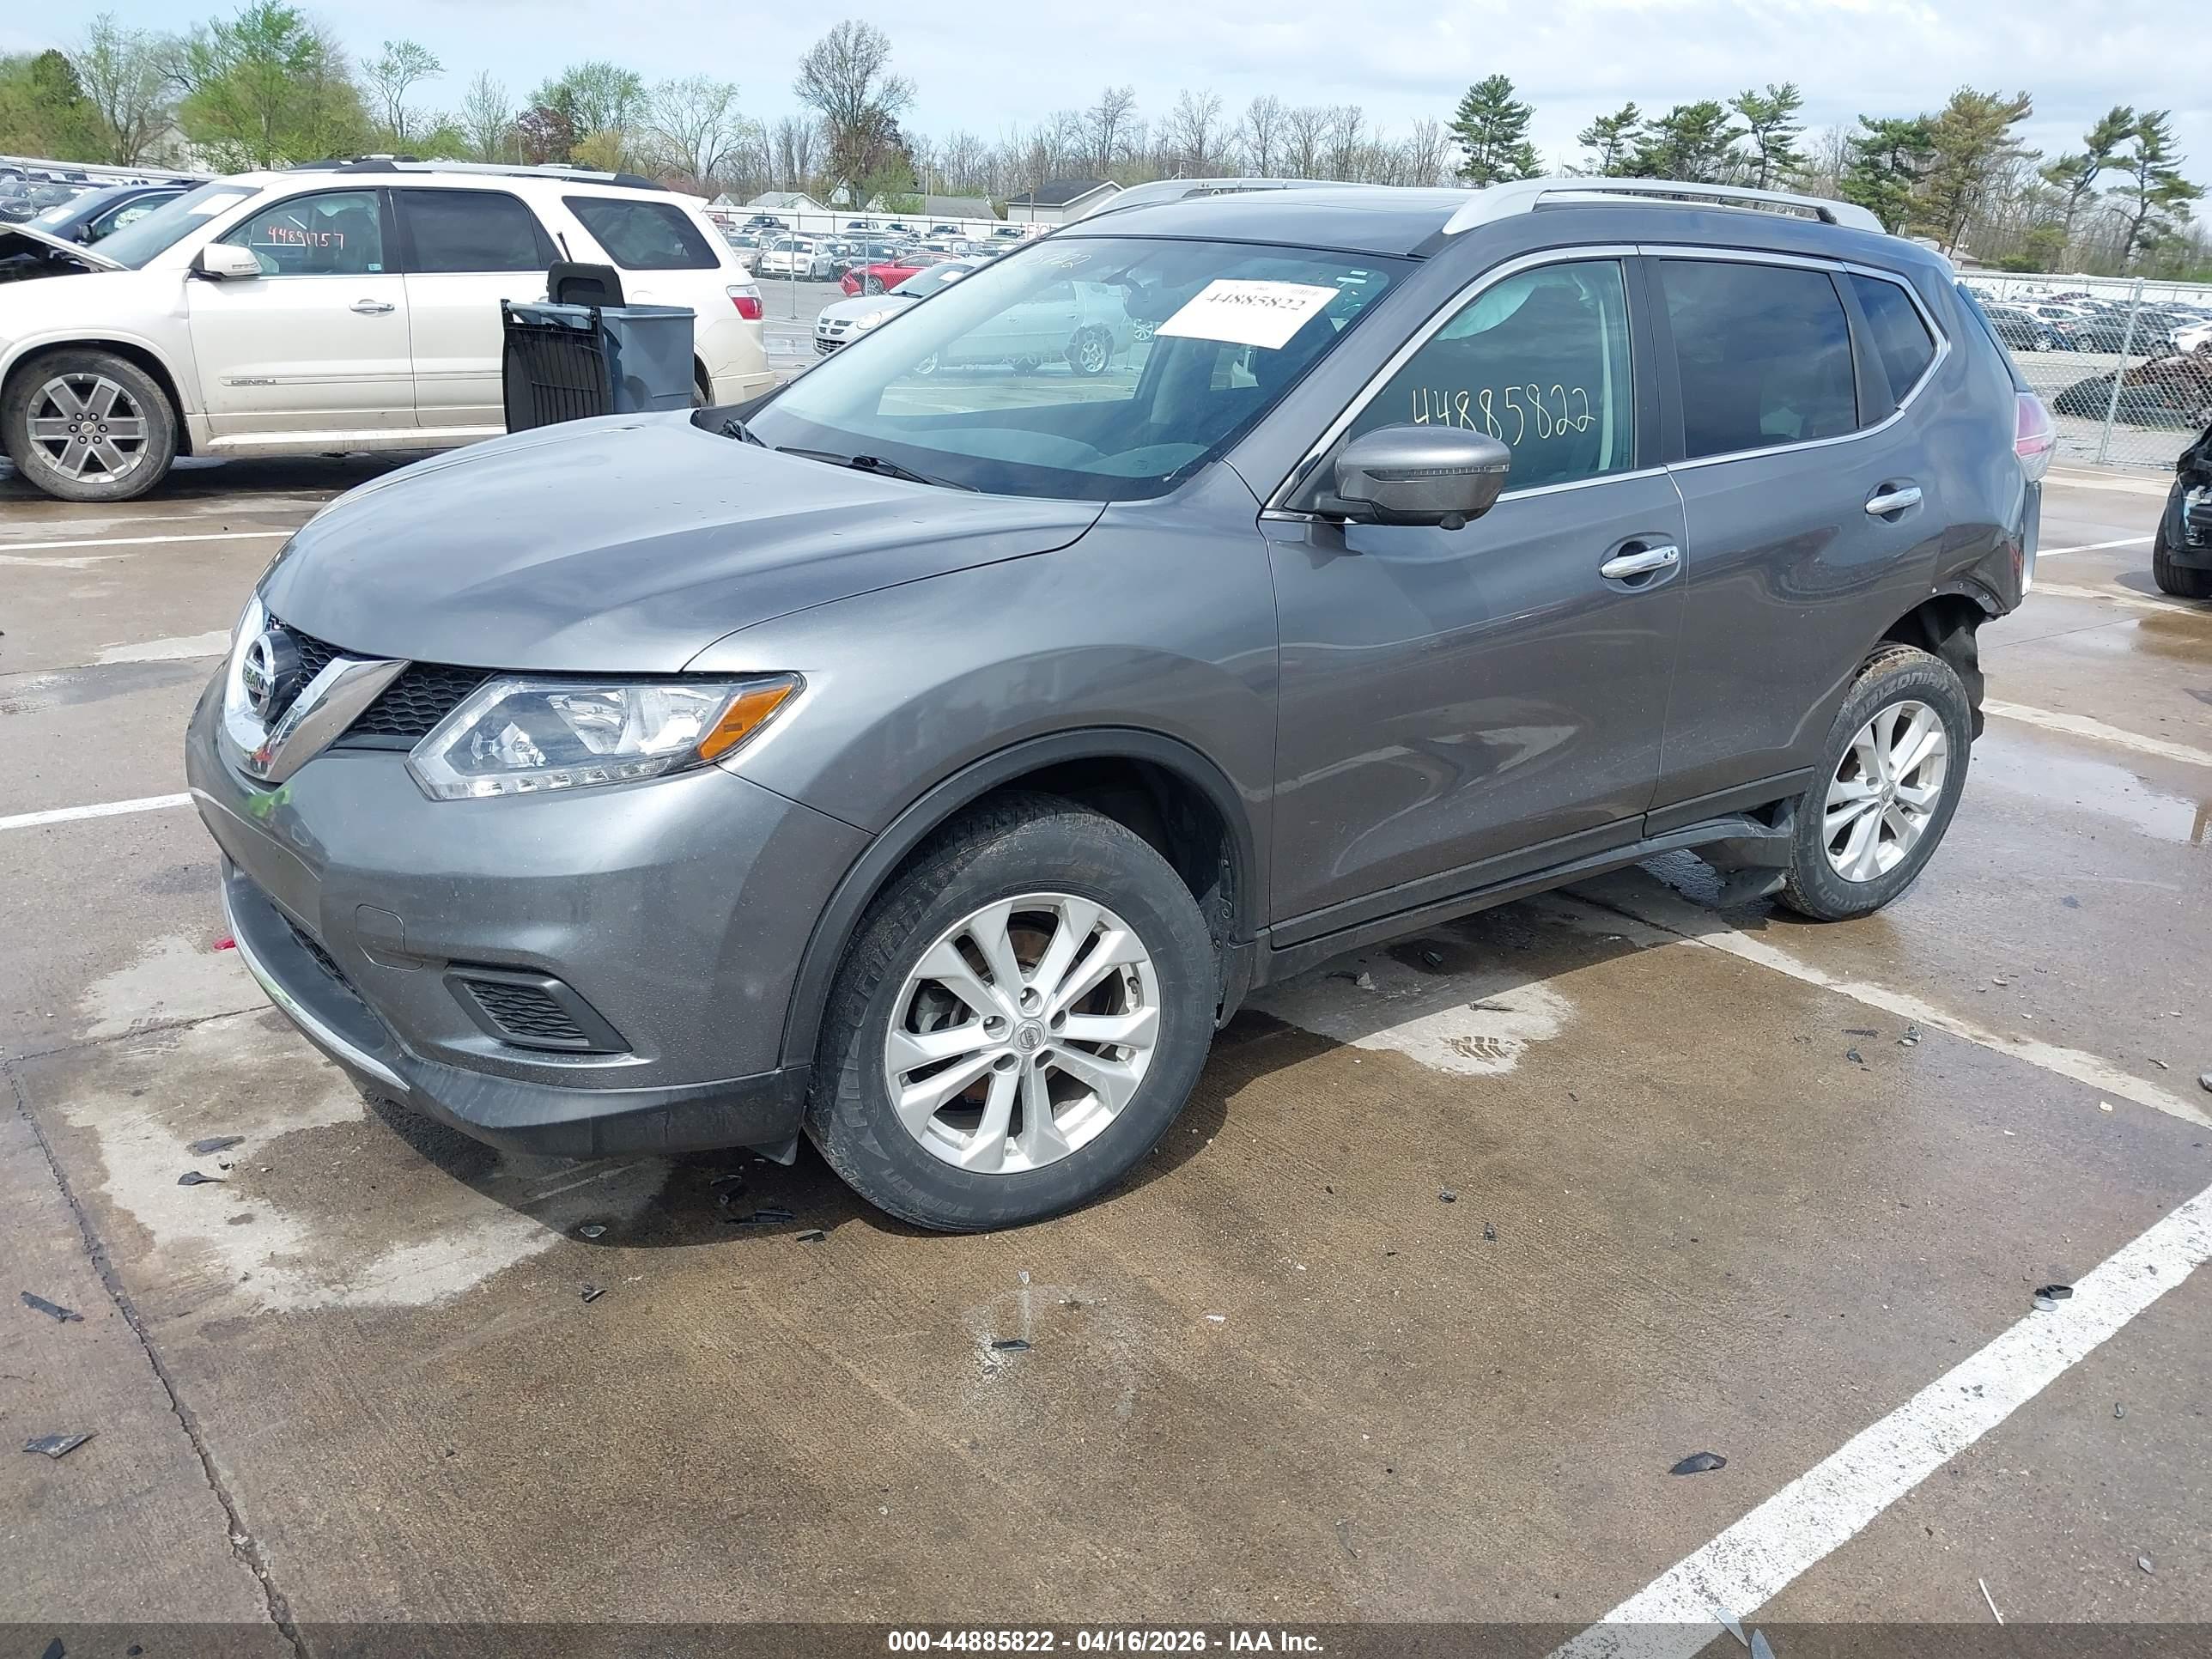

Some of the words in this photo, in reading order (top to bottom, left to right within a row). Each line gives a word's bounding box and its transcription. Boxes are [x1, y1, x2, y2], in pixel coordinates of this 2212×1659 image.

[268, 226, 343, 251] 44891757
[1206, 292, 1308, 311] 44885822
[1412, 384, 1596, 447] 44885822
